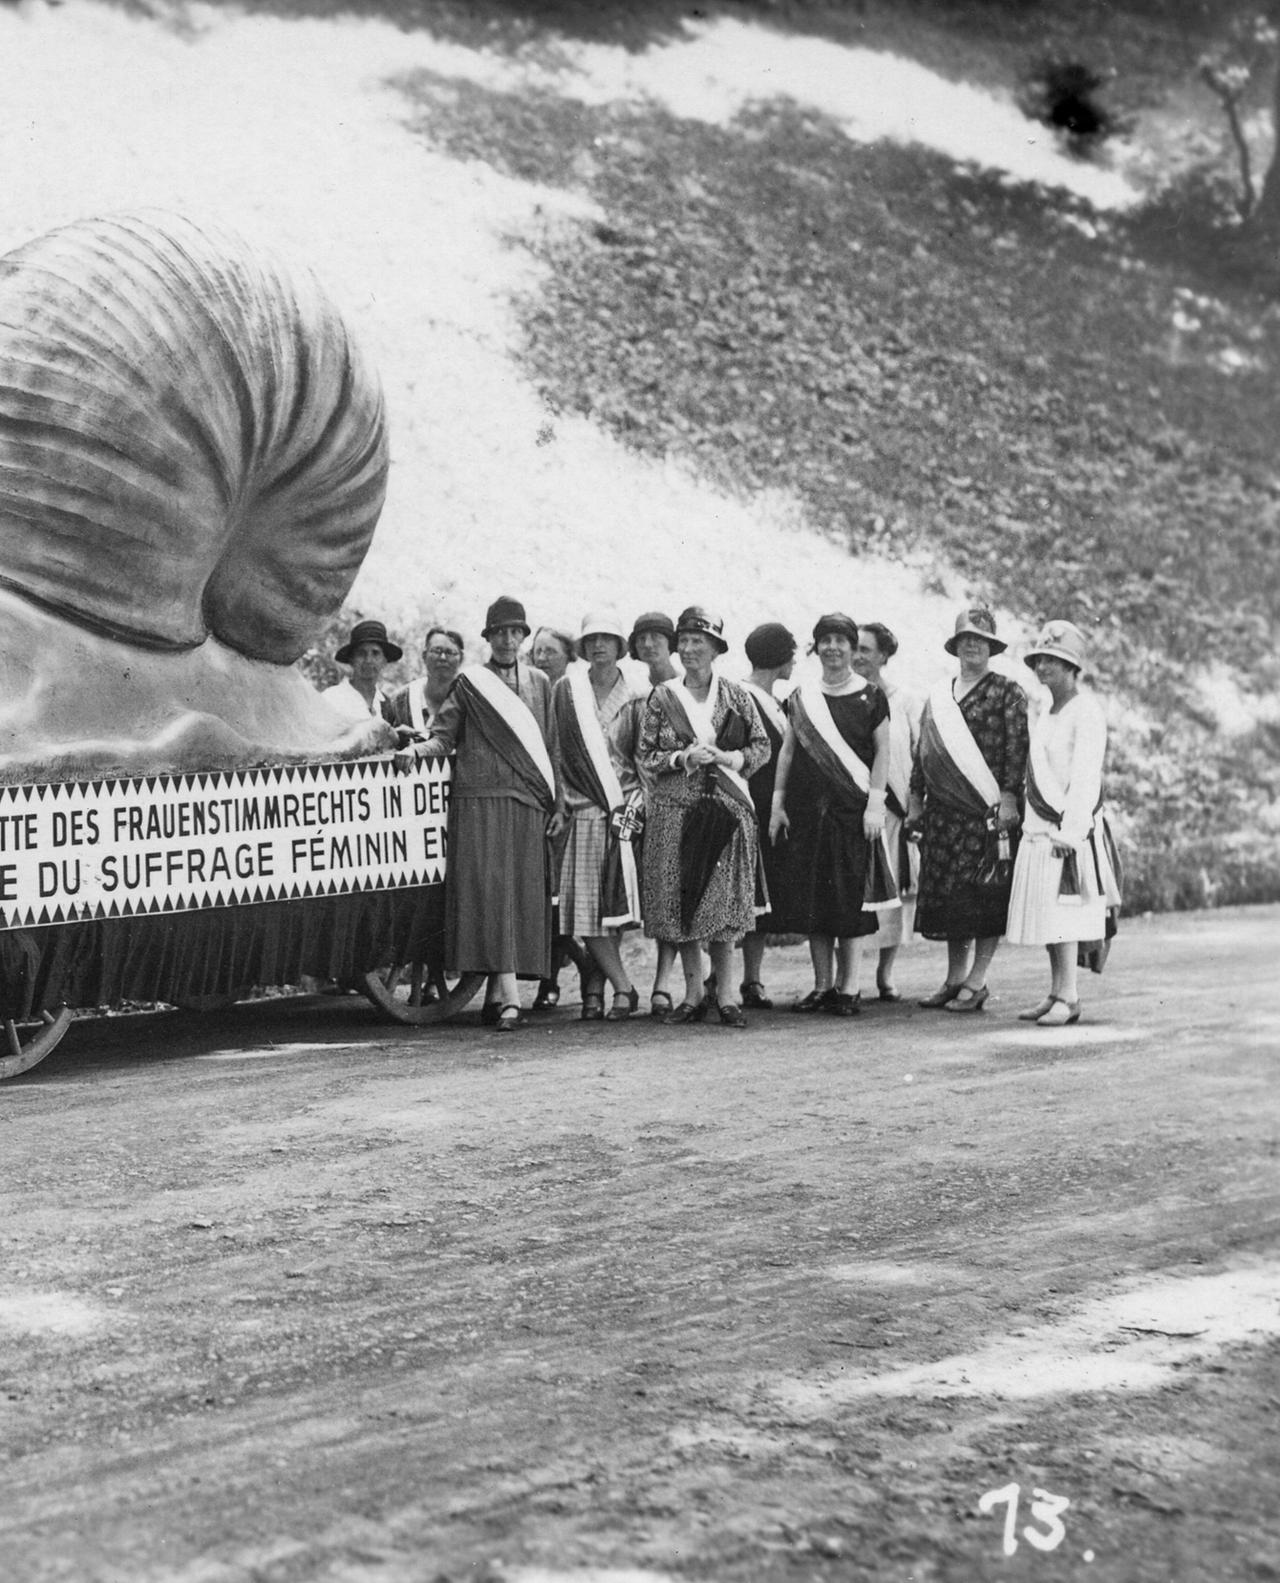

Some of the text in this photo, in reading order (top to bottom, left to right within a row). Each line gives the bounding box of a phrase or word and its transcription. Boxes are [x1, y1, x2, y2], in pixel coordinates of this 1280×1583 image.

[52, 809, 100, 847] DES
[113, 788, 370, 842] FRAUENSTIMMRECHTS
[382, 785, 402, 819] IN
[39, 858, 81, 898] DU
[101, 842, 274, 892] SUFFRAGE
[291, 829, 408, 873] FÉMININ
